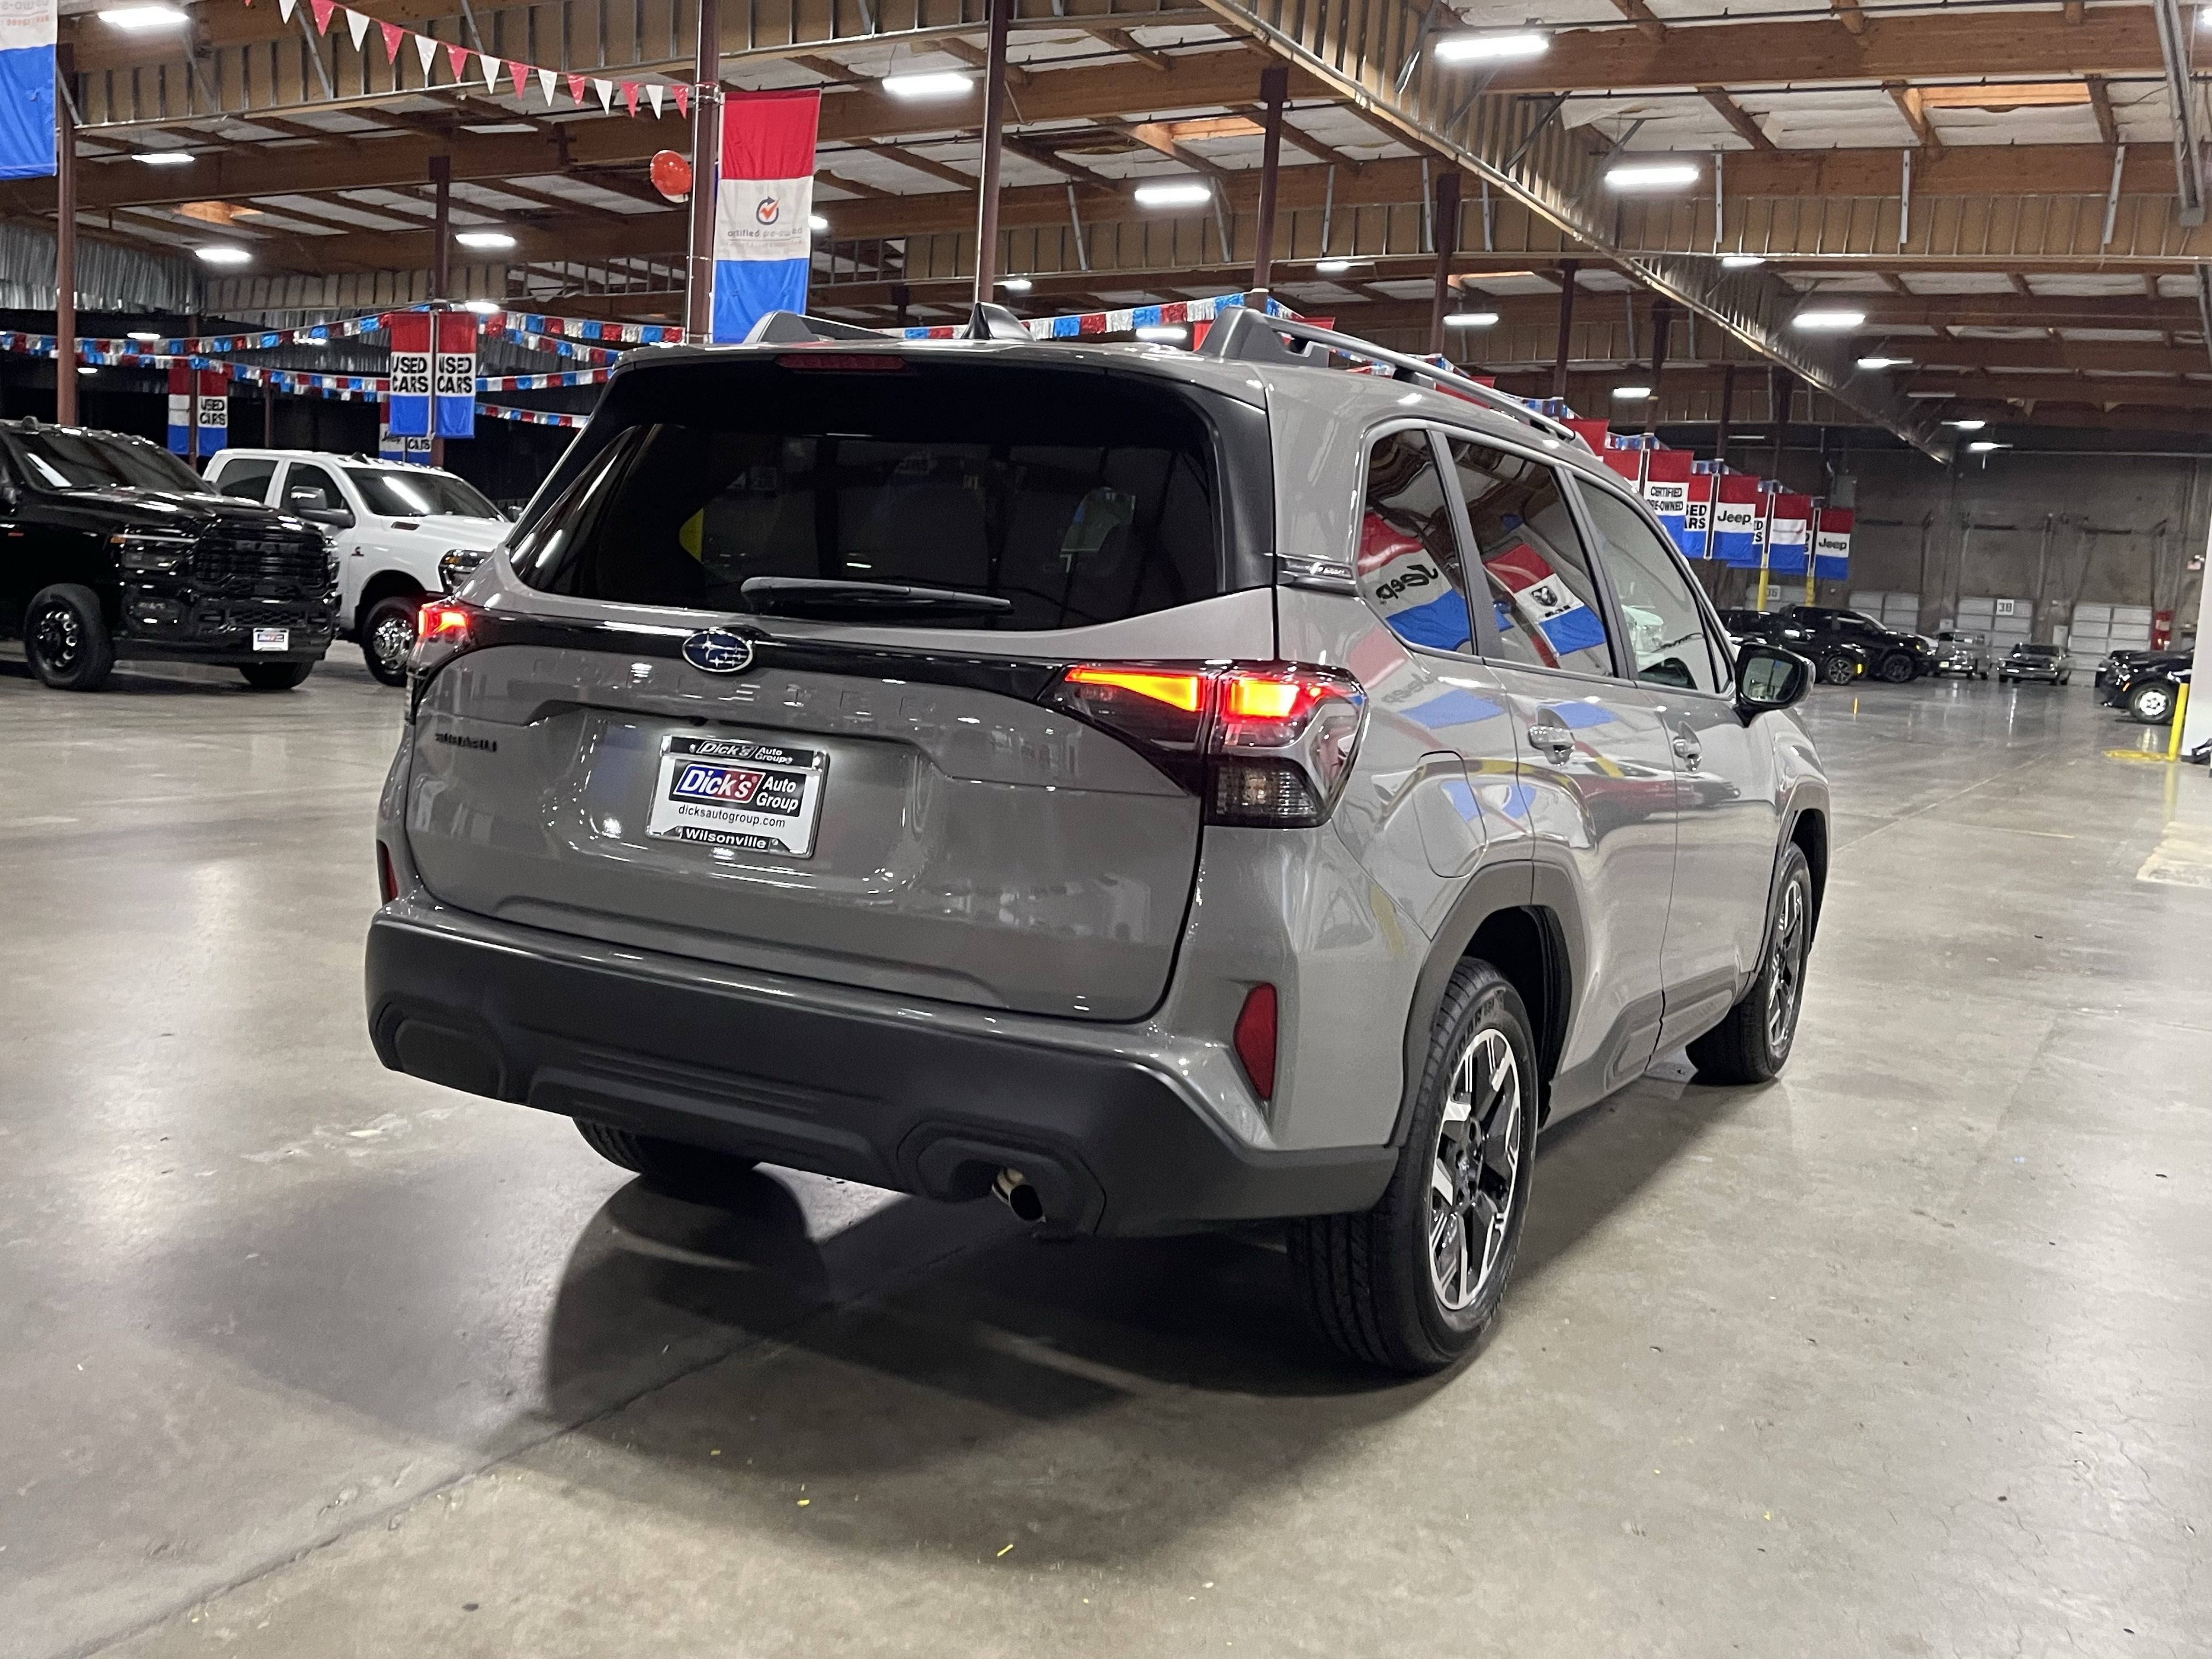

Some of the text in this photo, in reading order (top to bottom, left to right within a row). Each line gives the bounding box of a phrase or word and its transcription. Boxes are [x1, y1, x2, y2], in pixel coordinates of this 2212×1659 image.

[391, 356, 427, 374] USED
[438, 357, 472, 374] USED
[392, 376, 429, 393] CARS
[437, 375, 472, 393] CARS
[201, 398, 225, 411] USED
[1717, 510, 1751, 525] Jeep
[1819, 538, 1847, 551] Jeep
[701, 743, 783, 757] Dick's Auto
[754, 753, 787, 764] Group
[680, 769, 797, 798] Dick's Auto
[756, 792, 799, 813] Group
[678, 804, 786, 828] dicksautogroup.com
[686, 828, 766, 849] Wilsonville
